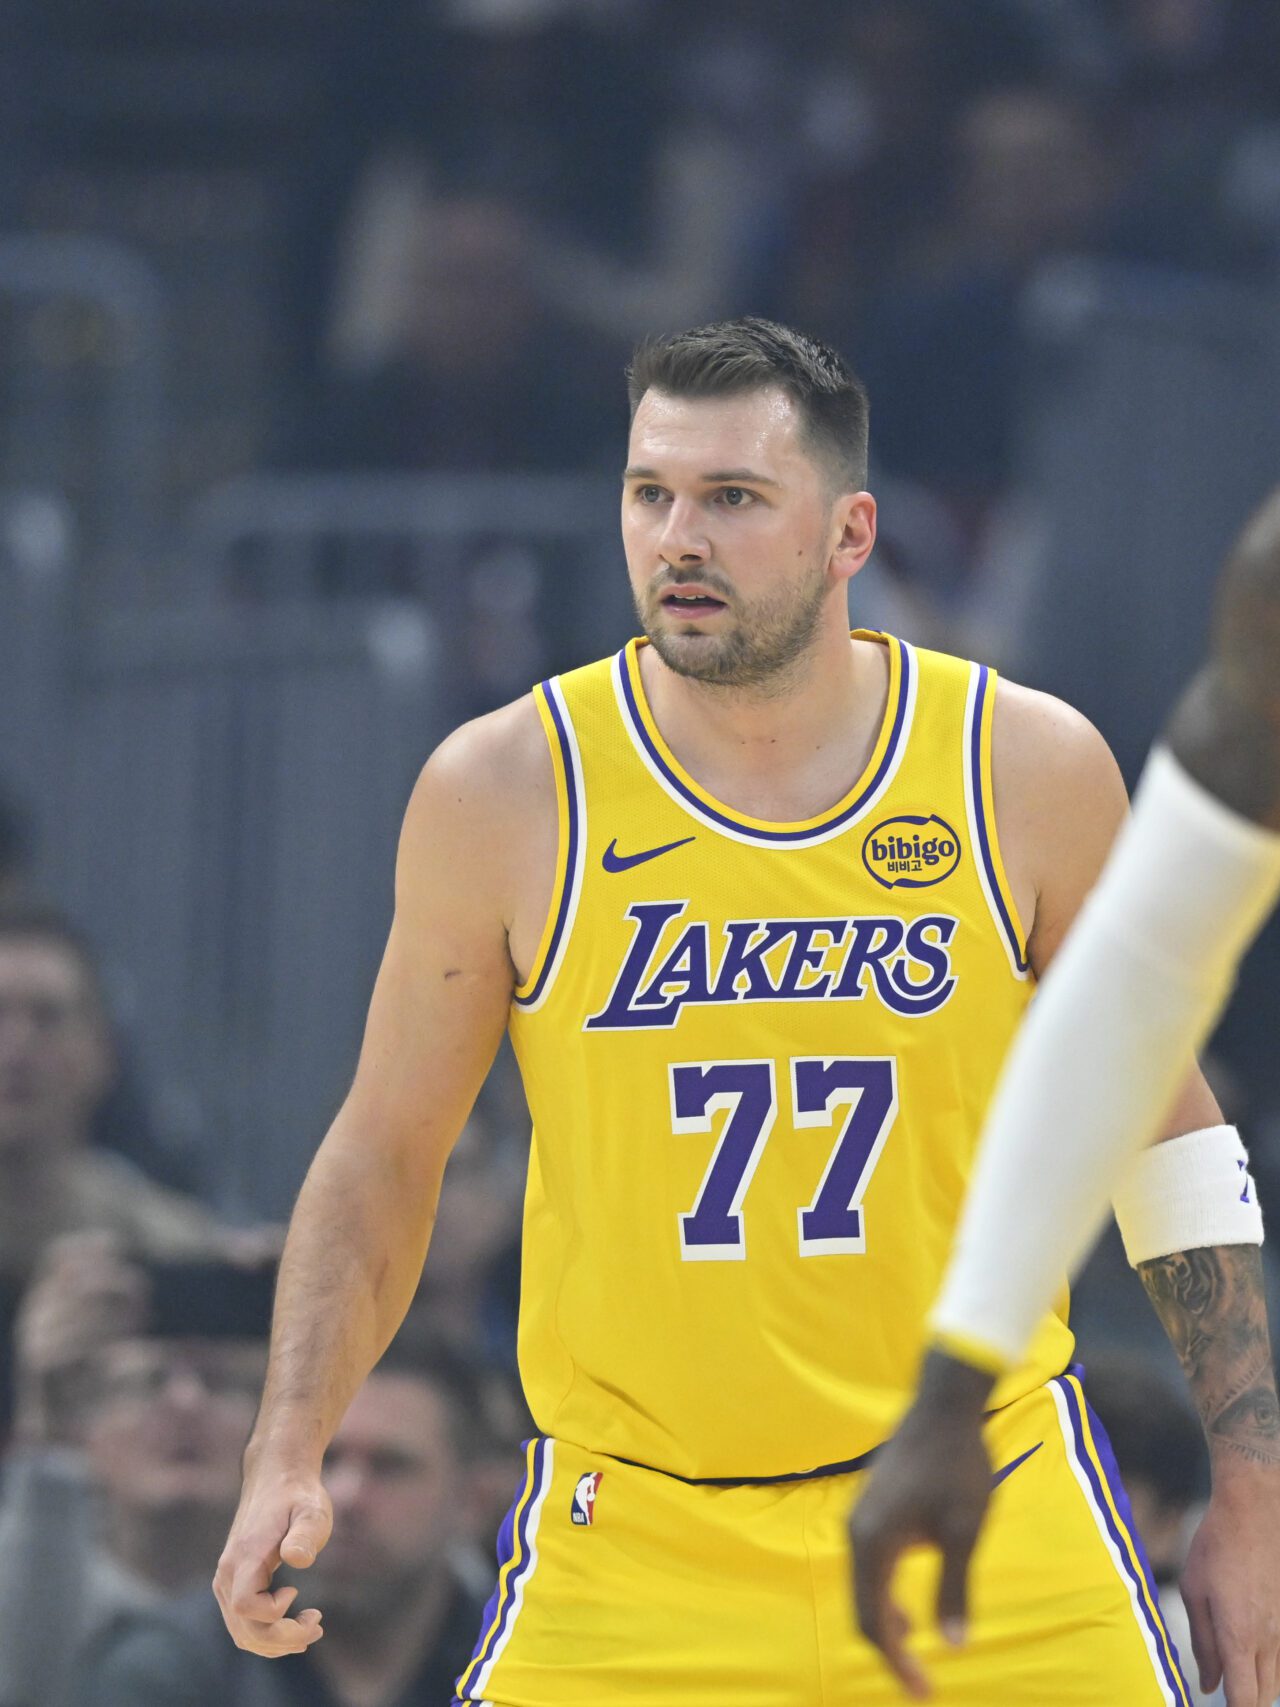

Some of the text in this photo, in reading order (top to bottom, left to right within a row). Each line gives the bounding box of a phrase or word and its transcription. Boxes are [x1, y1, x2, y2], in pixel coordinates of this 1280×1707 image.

[871, 834, 955, 866] bibigo
[887, 860, 923, 873] 비비고
[582, 900, 959, 1030] LAKERS
[667, 1056, 898, 1260] 77
